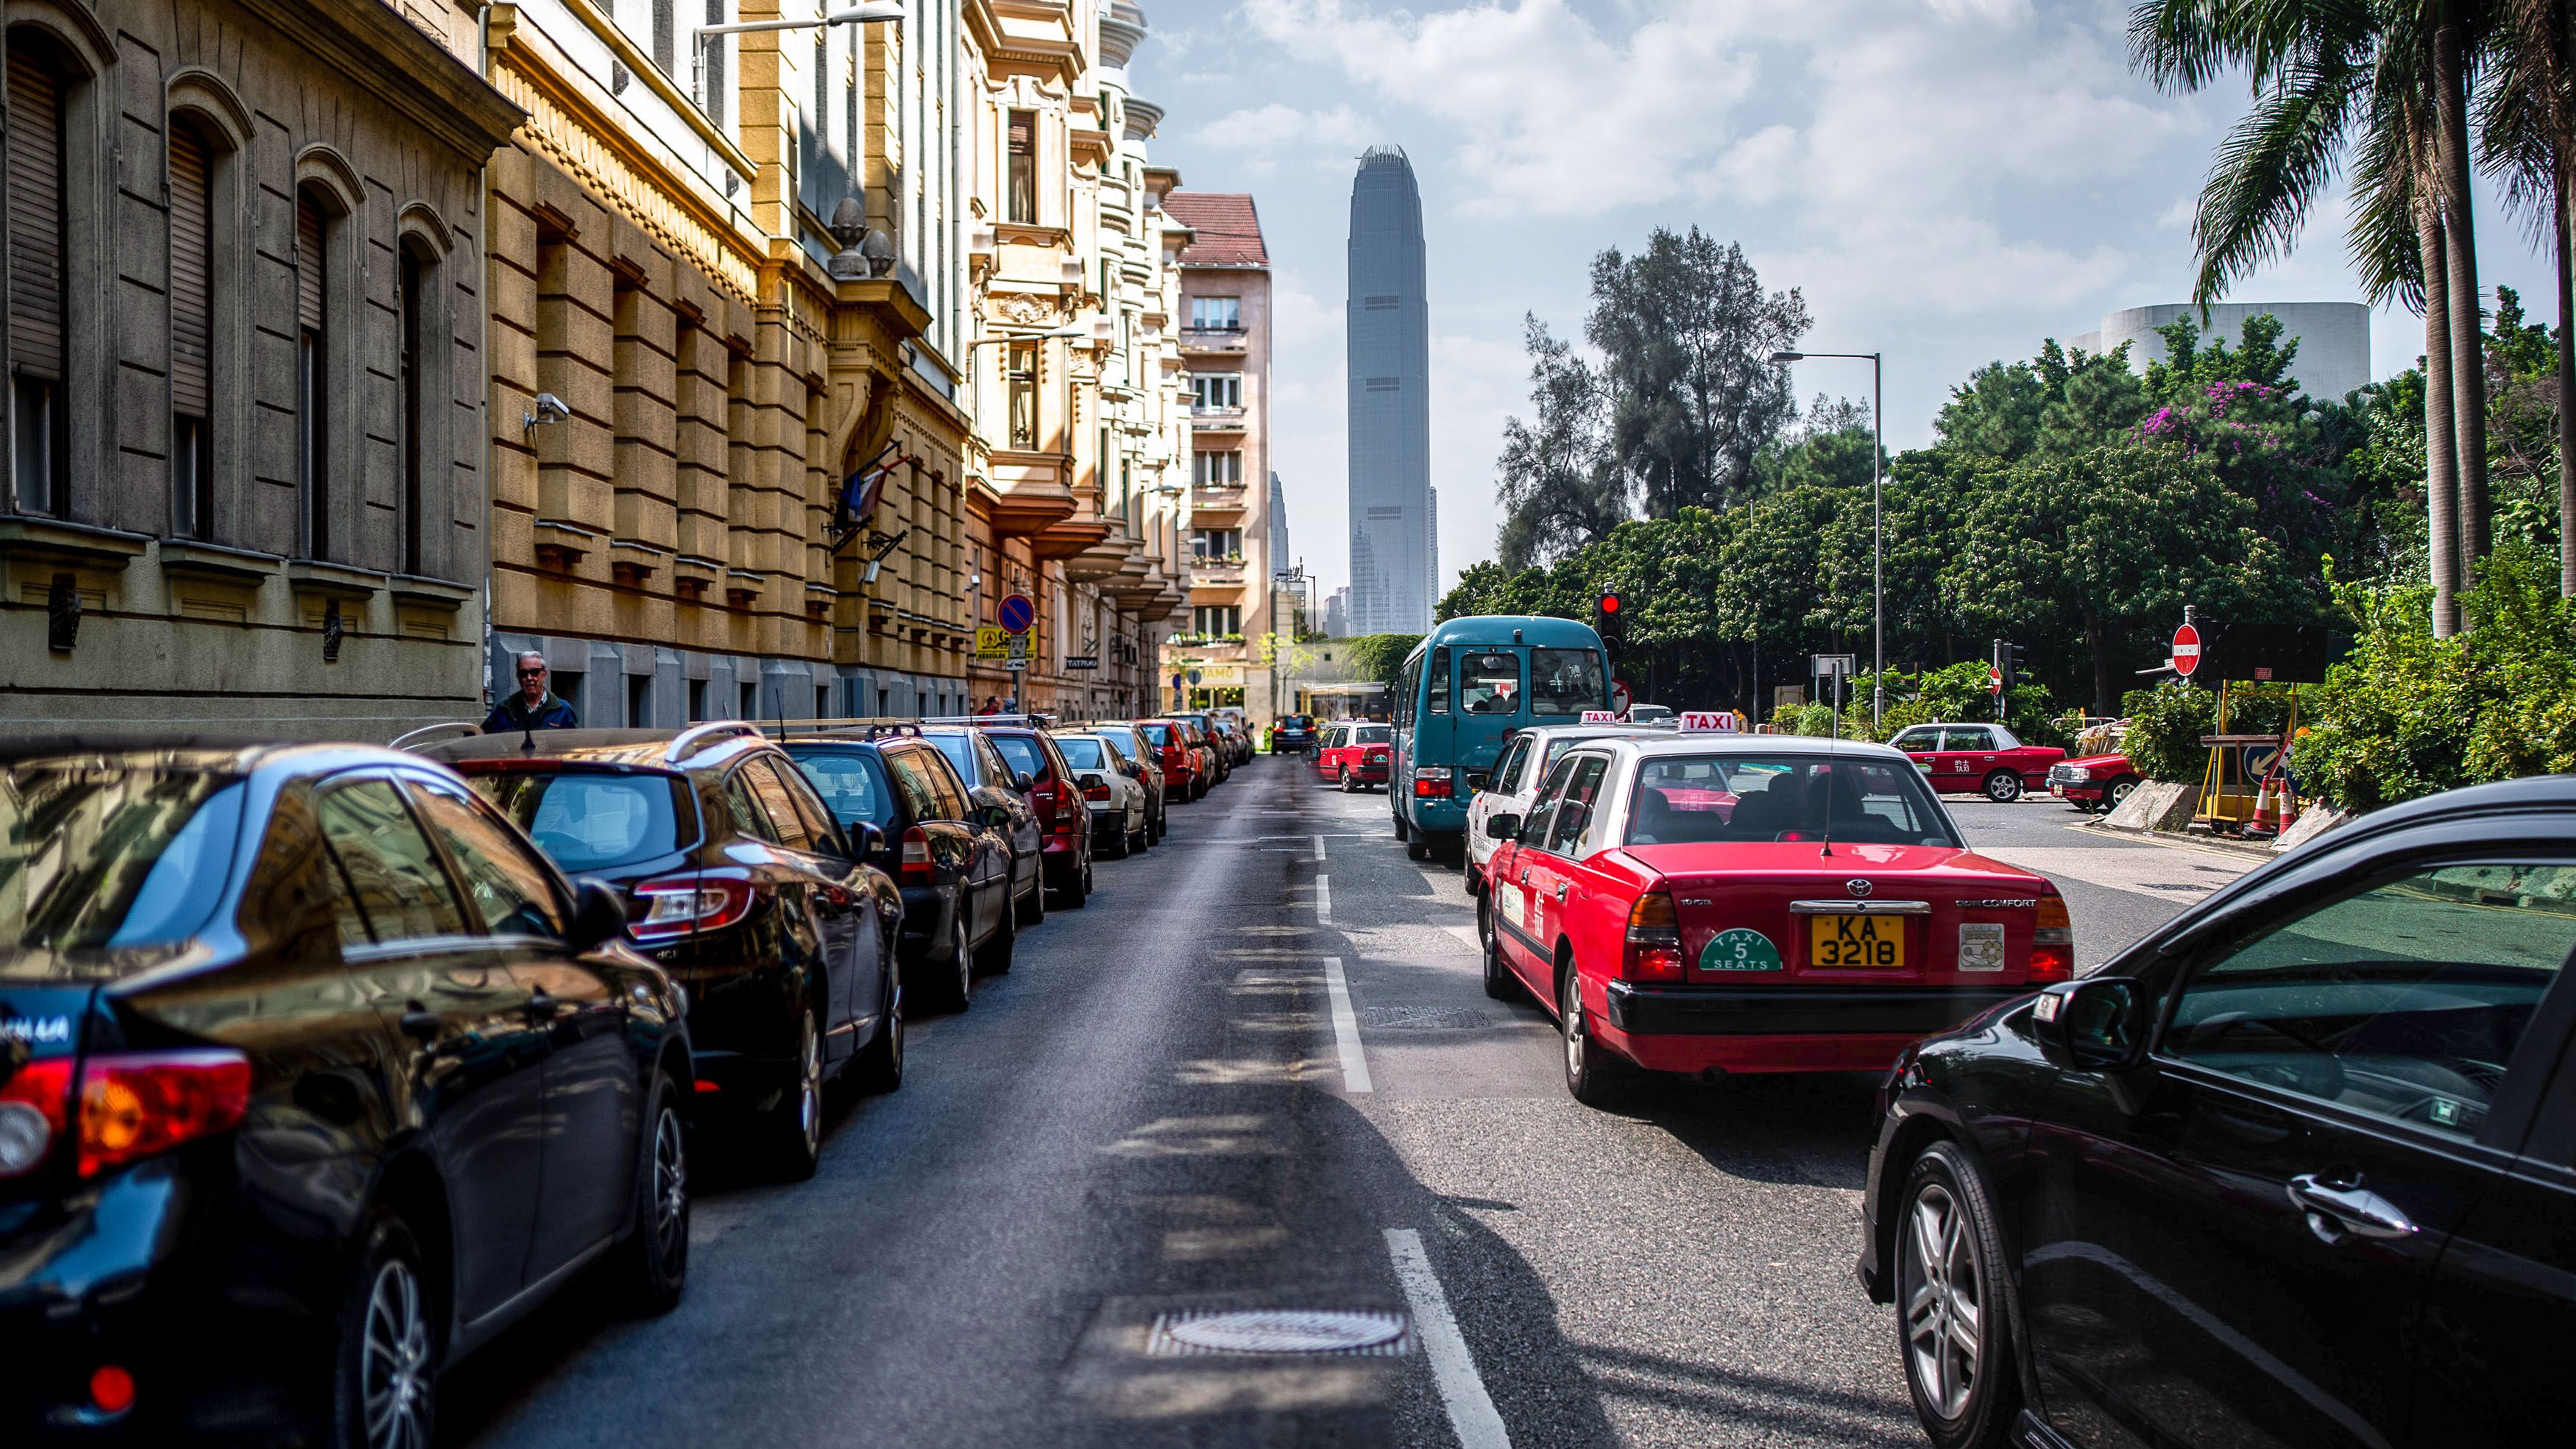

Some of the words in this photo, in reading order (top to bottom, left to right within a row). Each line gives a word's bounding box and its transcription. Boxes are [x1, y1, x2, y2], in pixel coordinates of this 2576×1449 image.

[1586, 712, 1613, 722] TAXI
[1686, 715, 1731, 729] TAXI
[1838, 916, 1878, 940] KA
[1715, 932, 1763, 946] TAXI
[1735, 943, 1748, 960] 5
[1821, 940, 1895, 966] 3218
[1714, 960, 1768, 970] SEATS
